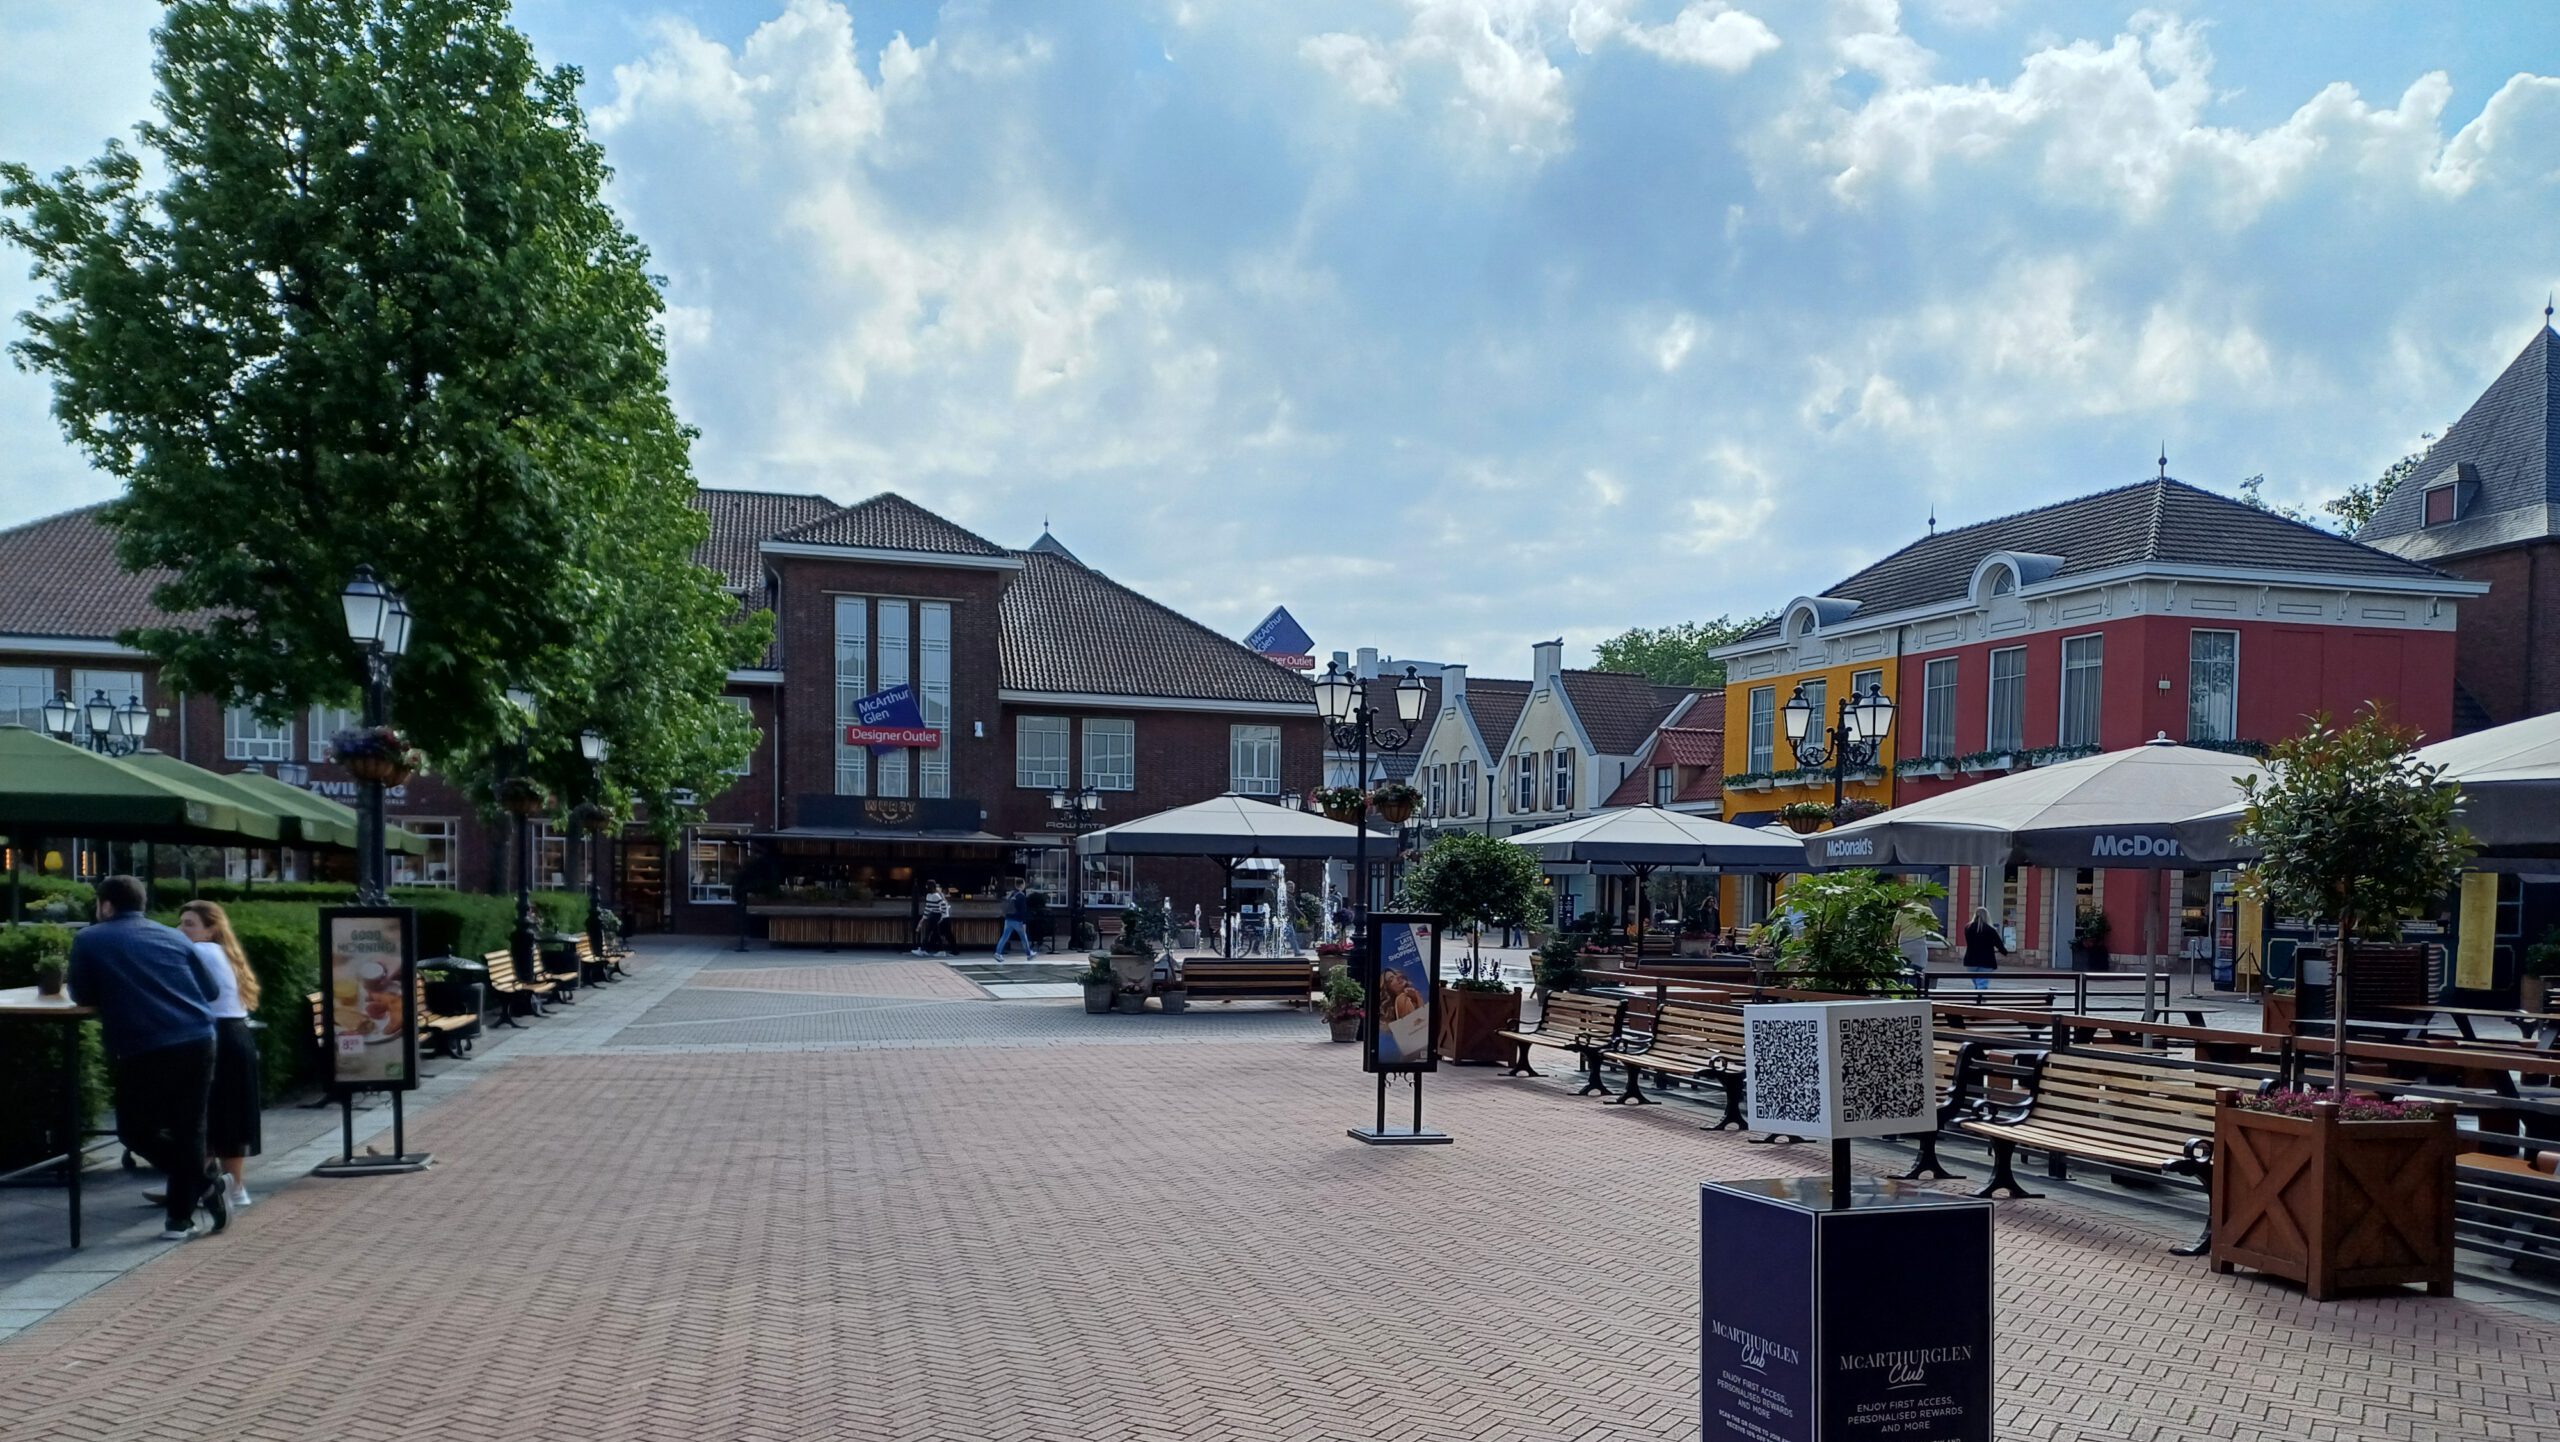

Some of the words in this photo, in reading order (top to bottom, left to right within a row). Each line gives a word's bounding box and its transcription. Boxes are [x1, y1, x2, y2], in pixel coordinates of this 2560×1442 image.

[1251, 612, 1283, 646] McArthur
[1257, 635, 1276, 652] Glen
[1287, 656, 1313, 666] Outlet
[858, 690, 909, 714] McArthur
[863, 709, 890, 724] Glen
[852, 728, 901, 743] Designer
[902, 730, 937, 742] Outlet
[1826, 838, 1873, 857] McDonald's
[2092, 835, 2184, 857] McDon
[1388, 946, 1417, 962] SHOPPING
[1741, 1342, 1766, 1368] Club
[1888, 1361, 1924, 1384] Club
[1722, 1370, 1741, 1383] ENJOY
[1742, 1379, 1759, 1392] FIRST
[1761, 1387, 1787, 1405] ACCESS,
[1717, 1378, 1761, 1404] PERSONALISED
[1762, 1398, 1793, 1418] REWARDS
[1857, 1402, 1887, 1413] ENJOY
[1890, 1399, 1914, 1410] FIRST
[1917, 1396, 1955, 1407] ACCESS,
[1738, 1399, 1751, 1410] AND
[1752, 1404, 1771, 1419] MORE
[1848, 1411, 1917, 1426] PERSONALISED
[1919, 1406, 1963, 1418] REWARDS
[1881, 1423, 1900, 1433] AND
[1904, 1421, 1931, 1431] MORE
